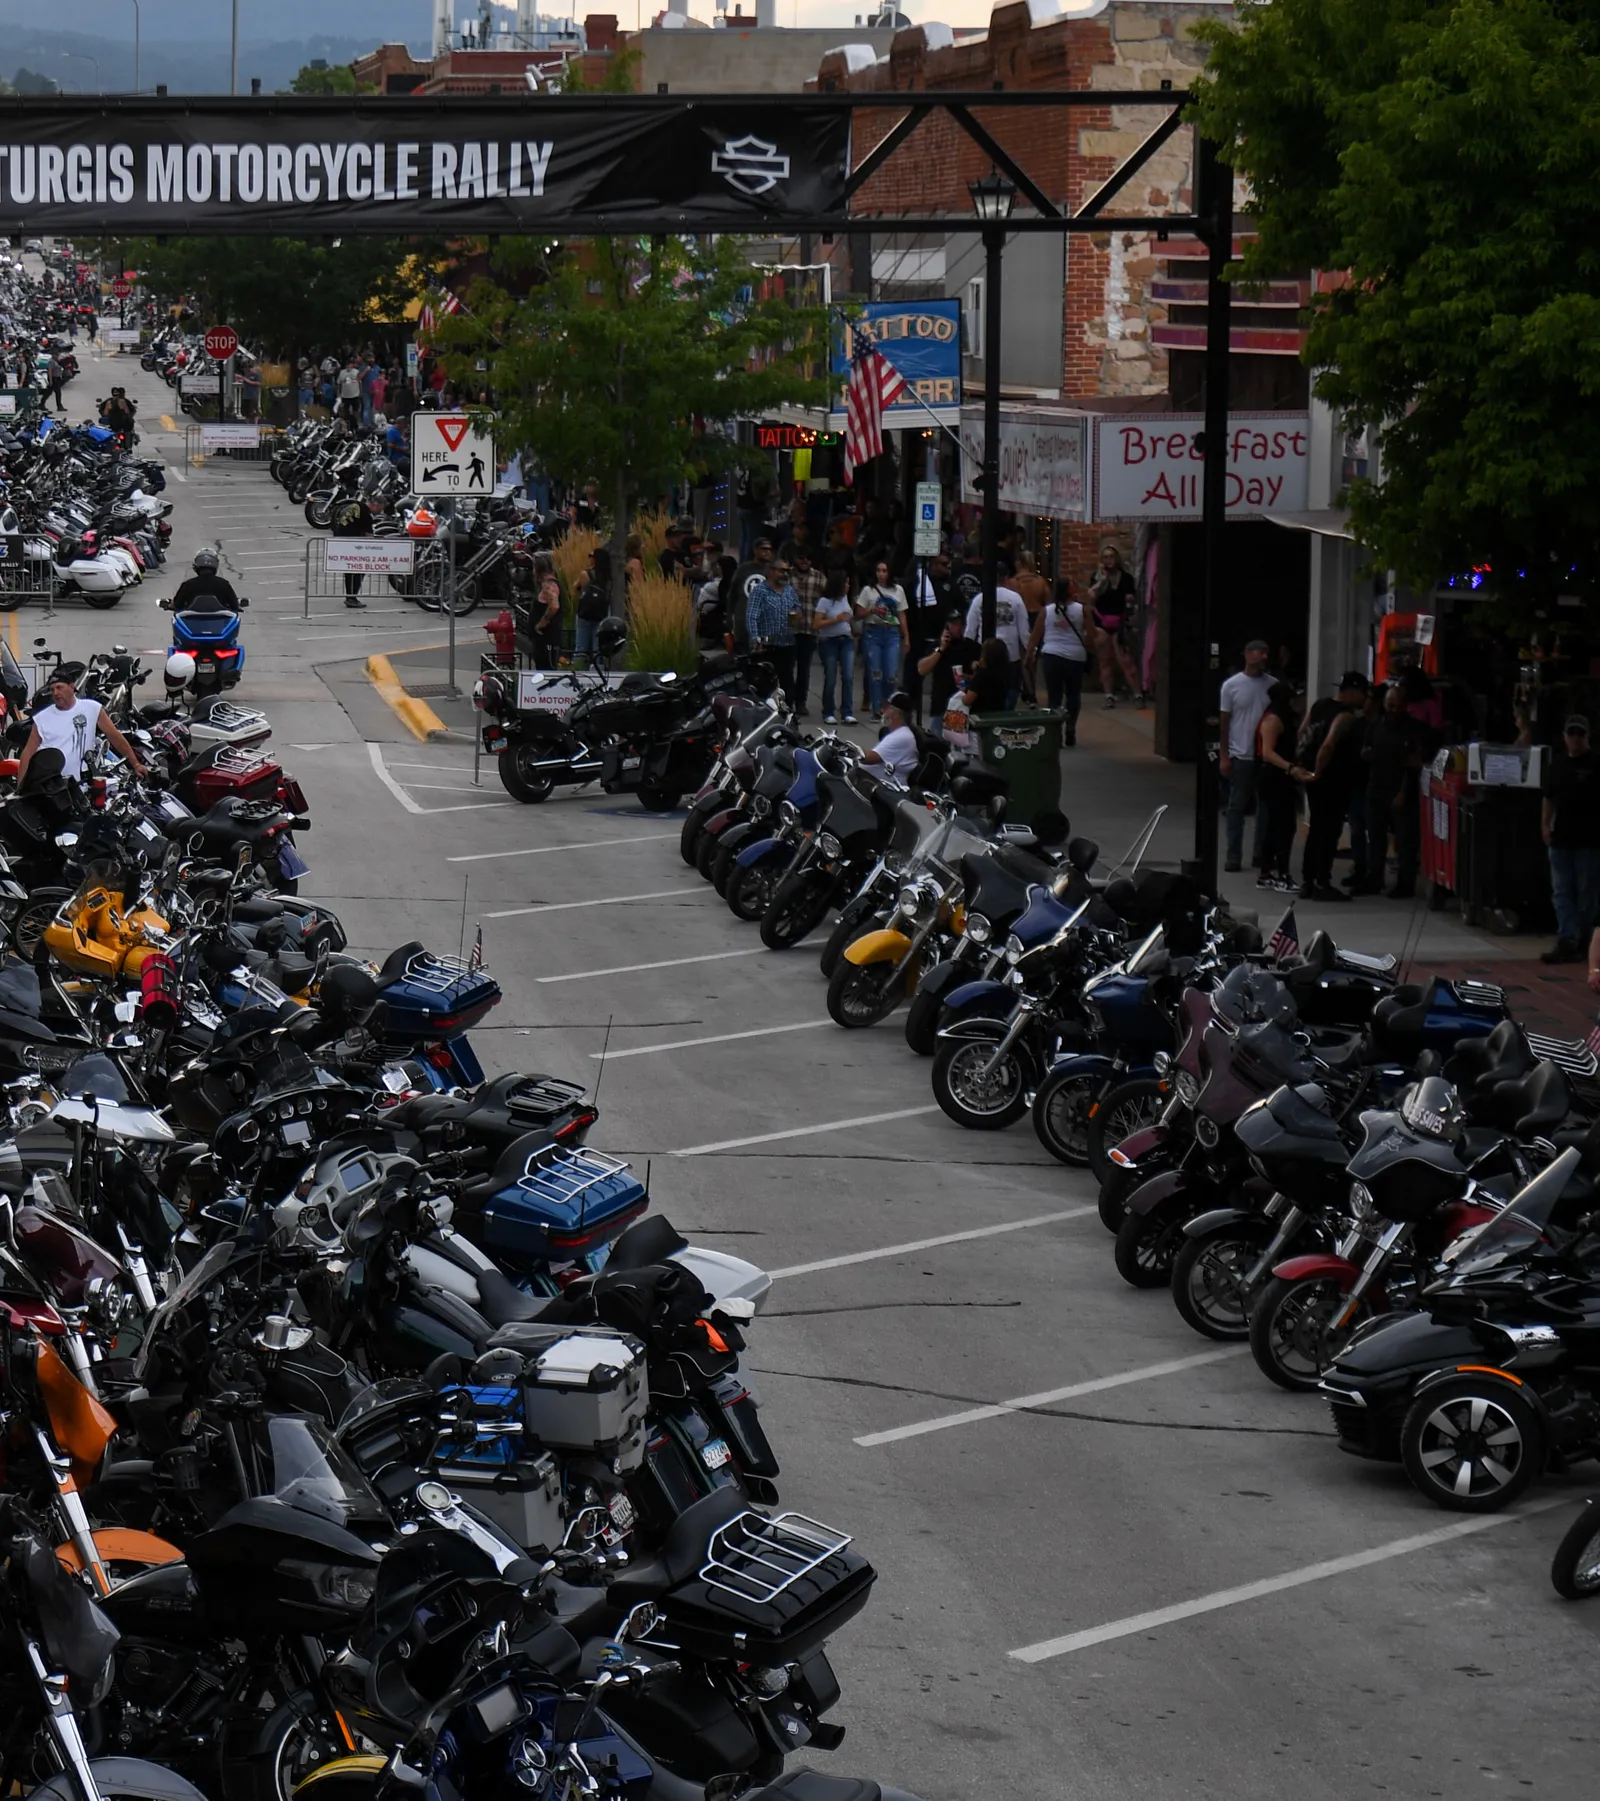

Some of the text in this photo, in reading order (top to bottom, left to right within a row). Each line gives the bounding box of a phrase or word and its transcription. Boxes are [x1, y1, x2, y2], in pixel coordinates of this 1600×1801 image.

[147, 143, 419, 202] MOTORCYCLE
[431, 142, 554, 199] RALLY
[114, 285, 131, 293] STOP
[206, 336, 236, 349] STOP
[1119, 426, 1307, 466] Breafast
[421, 451, 449, 463] HERE
[447, 475, 460, 486] TO
[1140, 471, 1284, 510] All Day
[364, 563, 391, 571] BLOCK
[523, 696, 537, 704] NO
